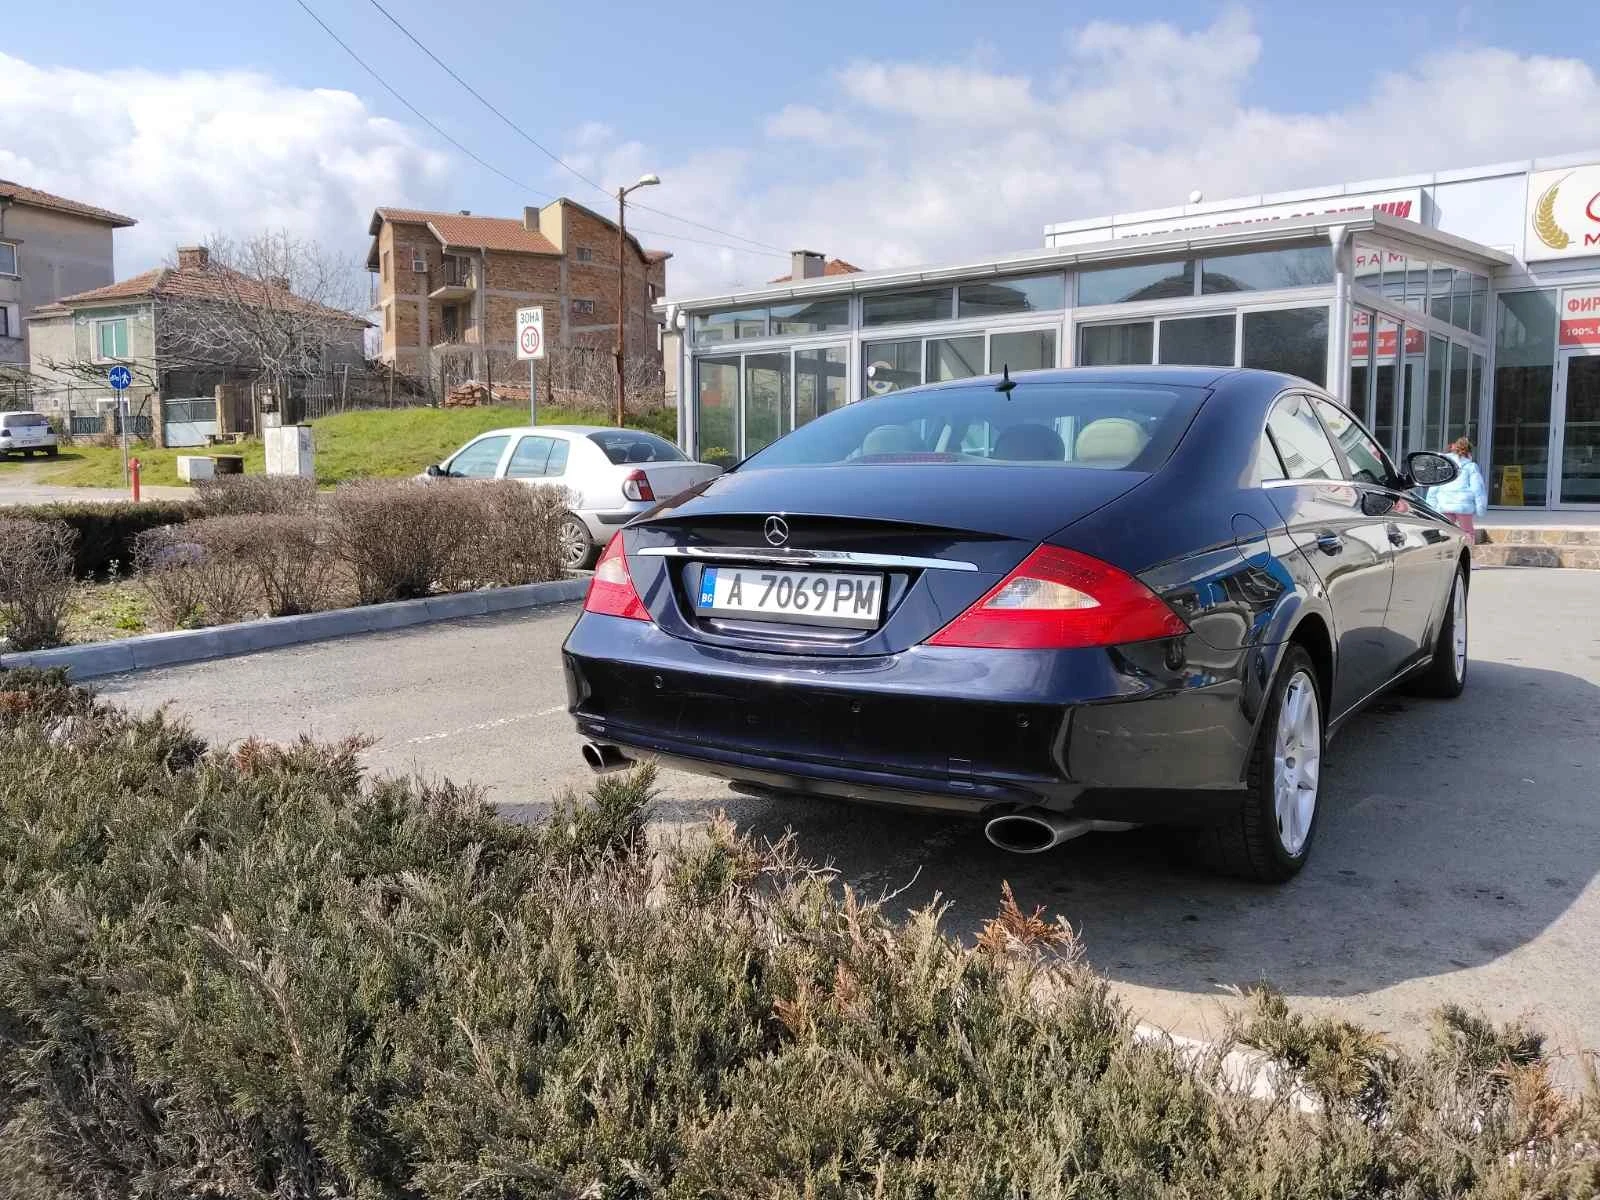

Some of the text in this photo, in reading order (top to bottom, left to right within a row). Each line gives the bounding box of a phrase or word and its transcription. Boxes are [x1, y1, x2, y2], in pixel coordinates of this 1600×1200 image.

[519, 311, 540, 324] ЗОНА
[524, 332, 537, 348] 30
[702, 594, 713, 604] BG
[727, 573, 876, 615] A 7069PM
